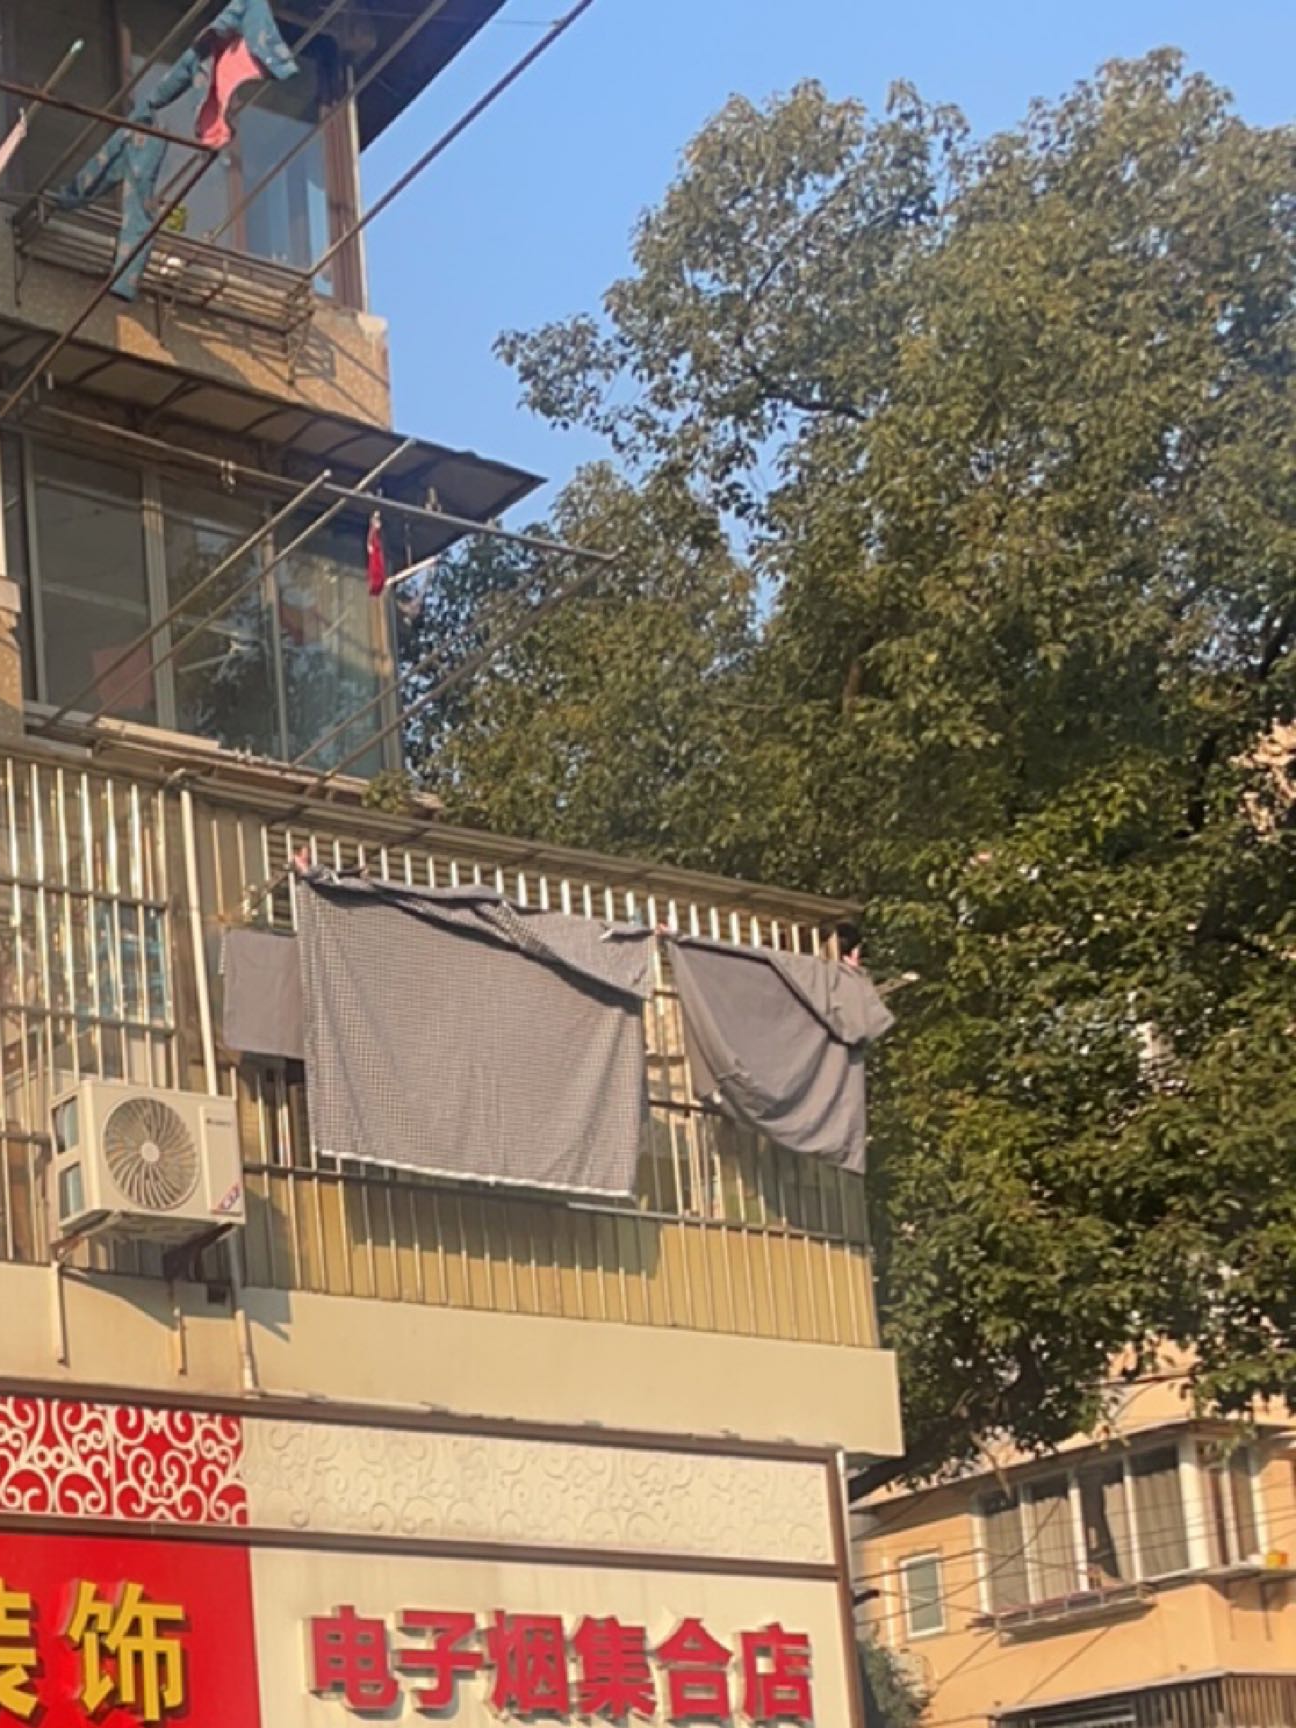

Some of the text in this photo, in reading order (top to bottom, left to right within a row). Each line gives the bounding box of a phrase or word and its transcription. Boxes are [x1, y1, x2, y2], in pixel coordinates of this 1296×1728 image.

[308, 1604, 814, 1724] 电子烟集合店
